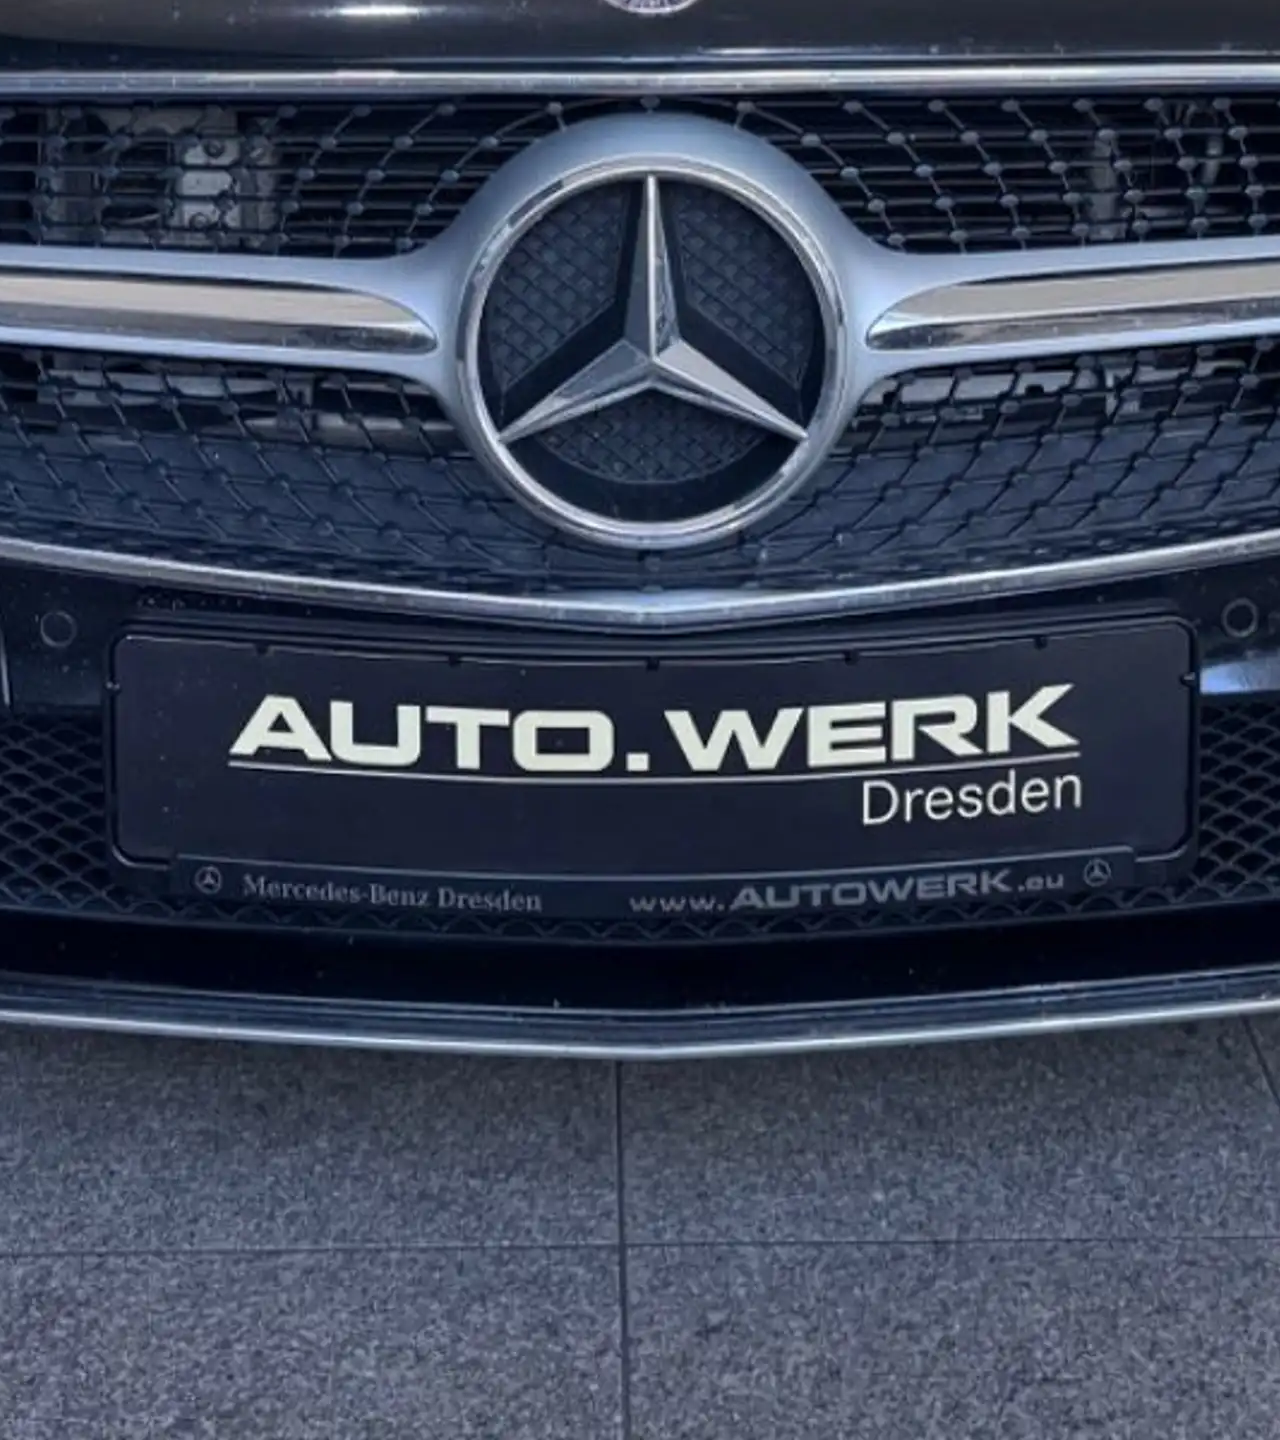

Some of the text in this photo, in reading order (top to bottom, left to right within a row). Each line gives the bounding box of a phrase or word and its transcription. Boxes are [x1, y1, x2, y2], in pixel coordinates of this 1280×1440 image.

[229, 683, 1081, 772] AUTO.WERK
[863, 769, 1082, 825] Dresden
[242, 873, 543, 912] Mercedes-Benz Dresden
[630, 869, 1065, 913] www.AUTOWERK.eu
